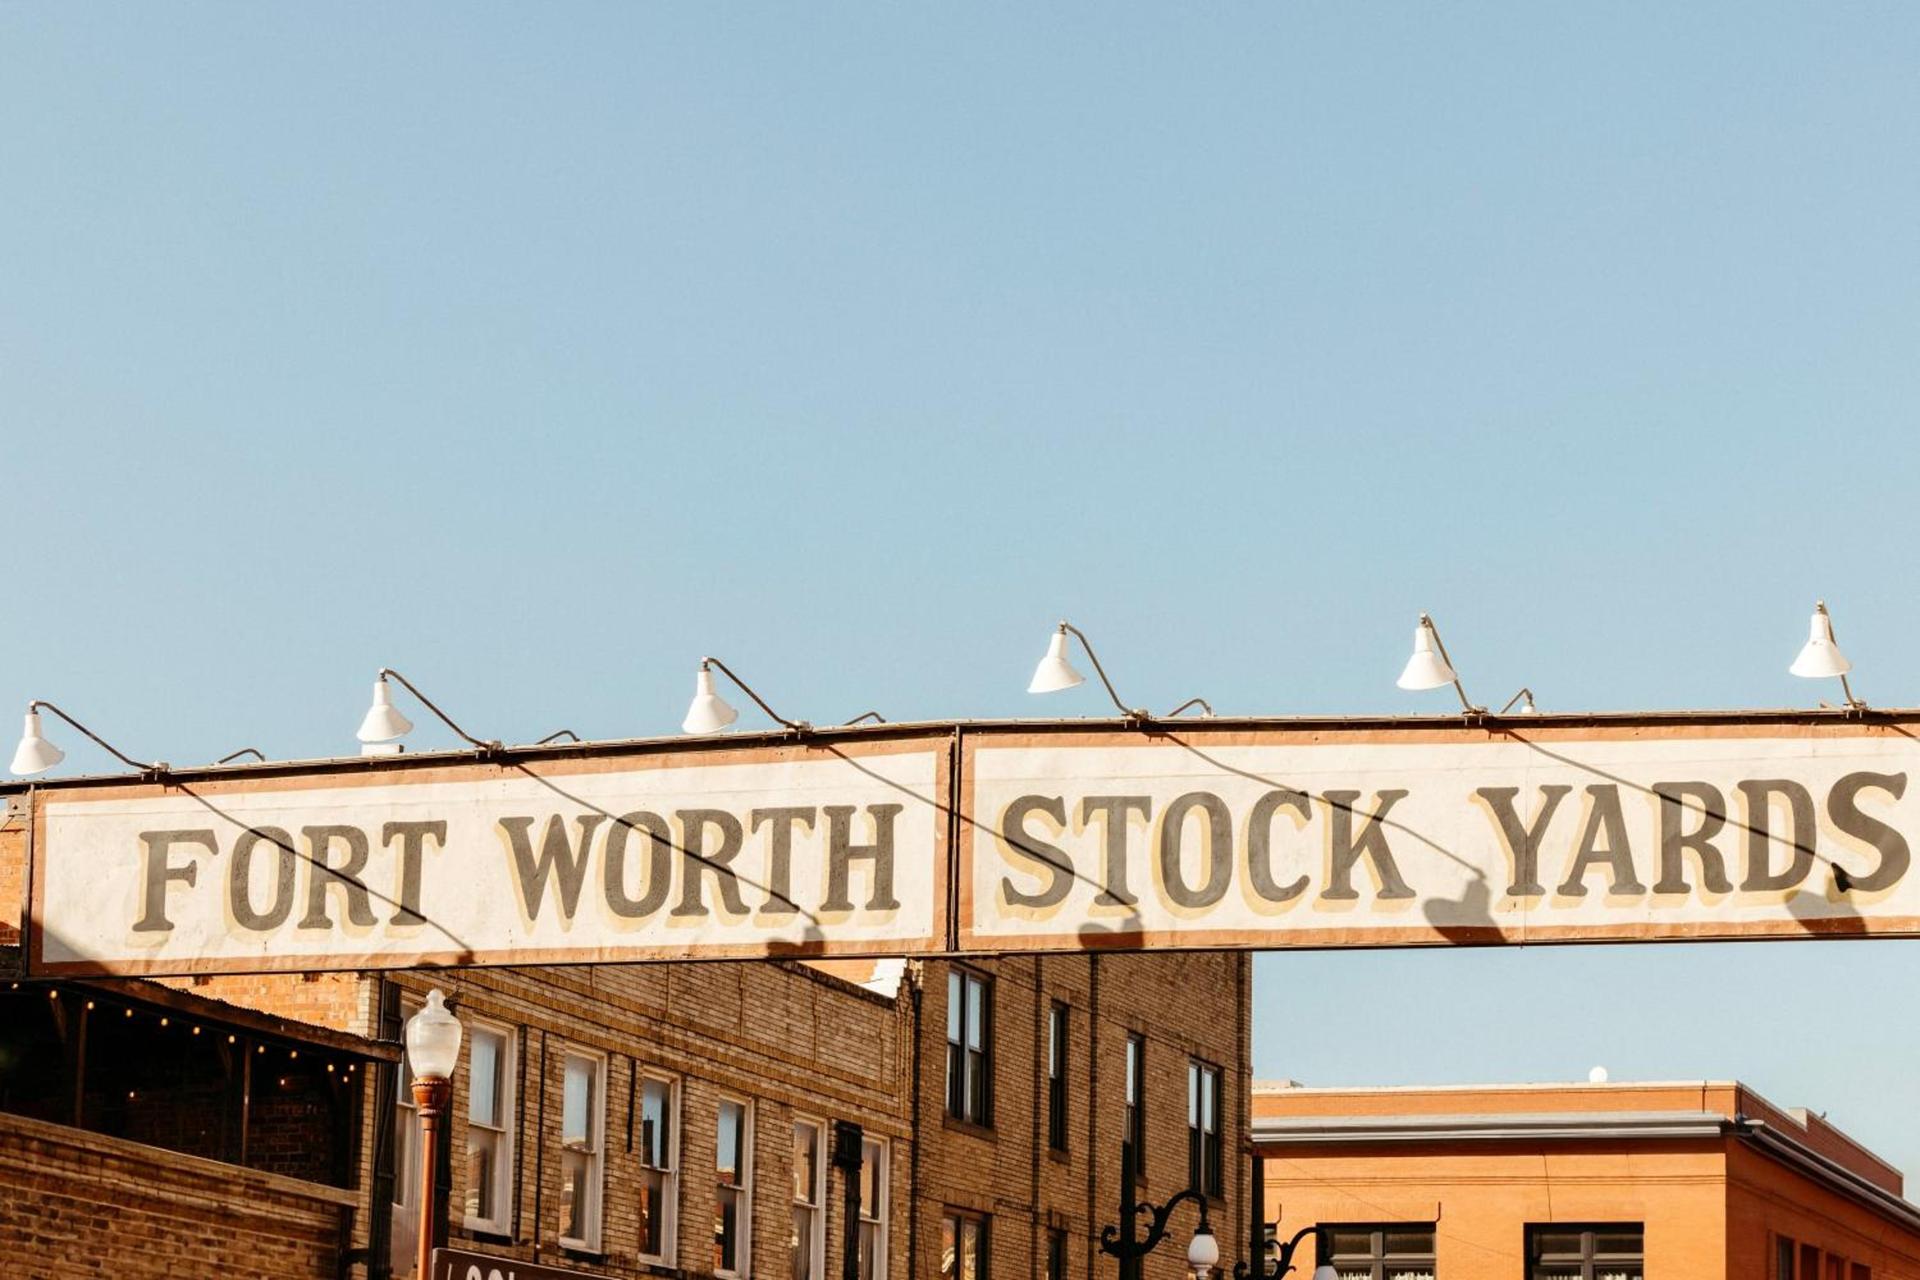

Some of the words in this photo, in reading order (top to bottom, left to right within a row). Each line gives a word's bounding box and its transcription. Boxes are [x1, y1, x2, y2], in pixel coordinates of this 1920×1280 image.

[132, 819, 448, 933] FORT
[499, 803, 904, 922] WORTH
[1000, 788, 1417, 909] STOCK
[1474, 771, 1910, 899] YARDS
